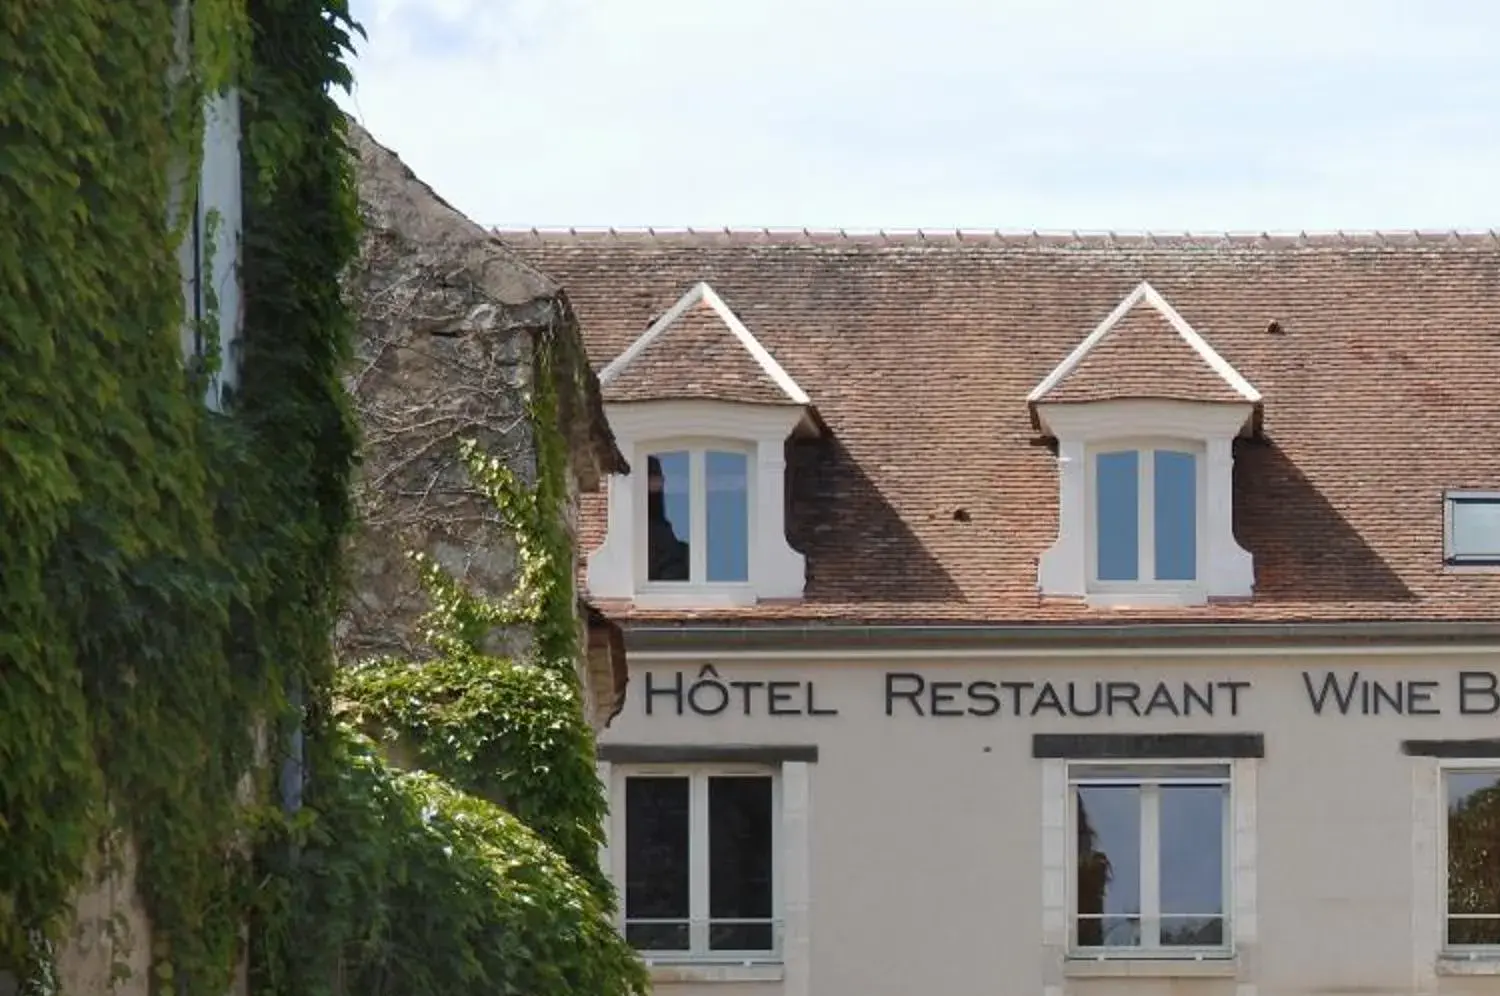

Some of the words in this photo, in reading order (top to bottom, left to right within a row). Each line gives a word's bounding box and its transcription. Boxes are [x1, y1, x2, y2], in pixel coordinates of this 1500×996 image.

[645, 663, 839, 717] HÔTEL
[884, 671, 1251, 718] RESTAURANT
[1302, 671, 1441, 716] WINE
